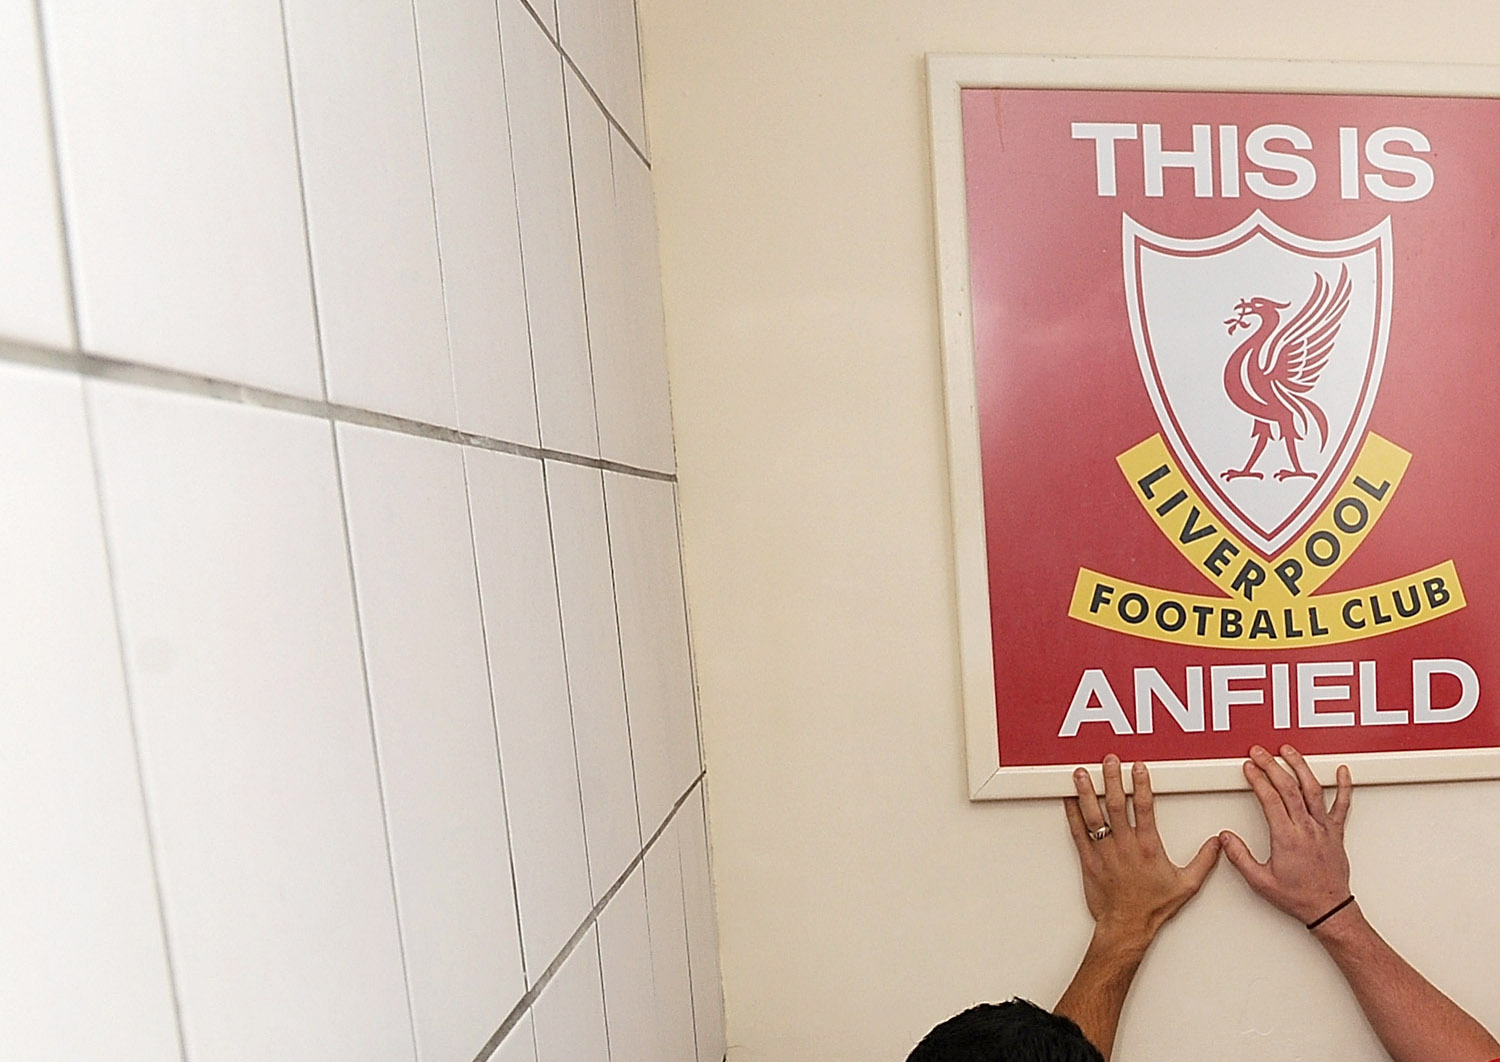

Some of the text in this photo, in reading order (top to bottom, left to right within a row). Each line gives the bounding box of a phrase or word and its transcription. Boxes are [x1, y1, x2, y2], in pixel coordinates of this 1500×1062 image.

[1070, 122, 1435, 202] THIS IS
[1136, 463, 1391, 602] LIVERPOOL
[1089, 575, 1451, 640] FOOTBALL CLUB
[1057, 657, 1481, 738] ANFIELD
